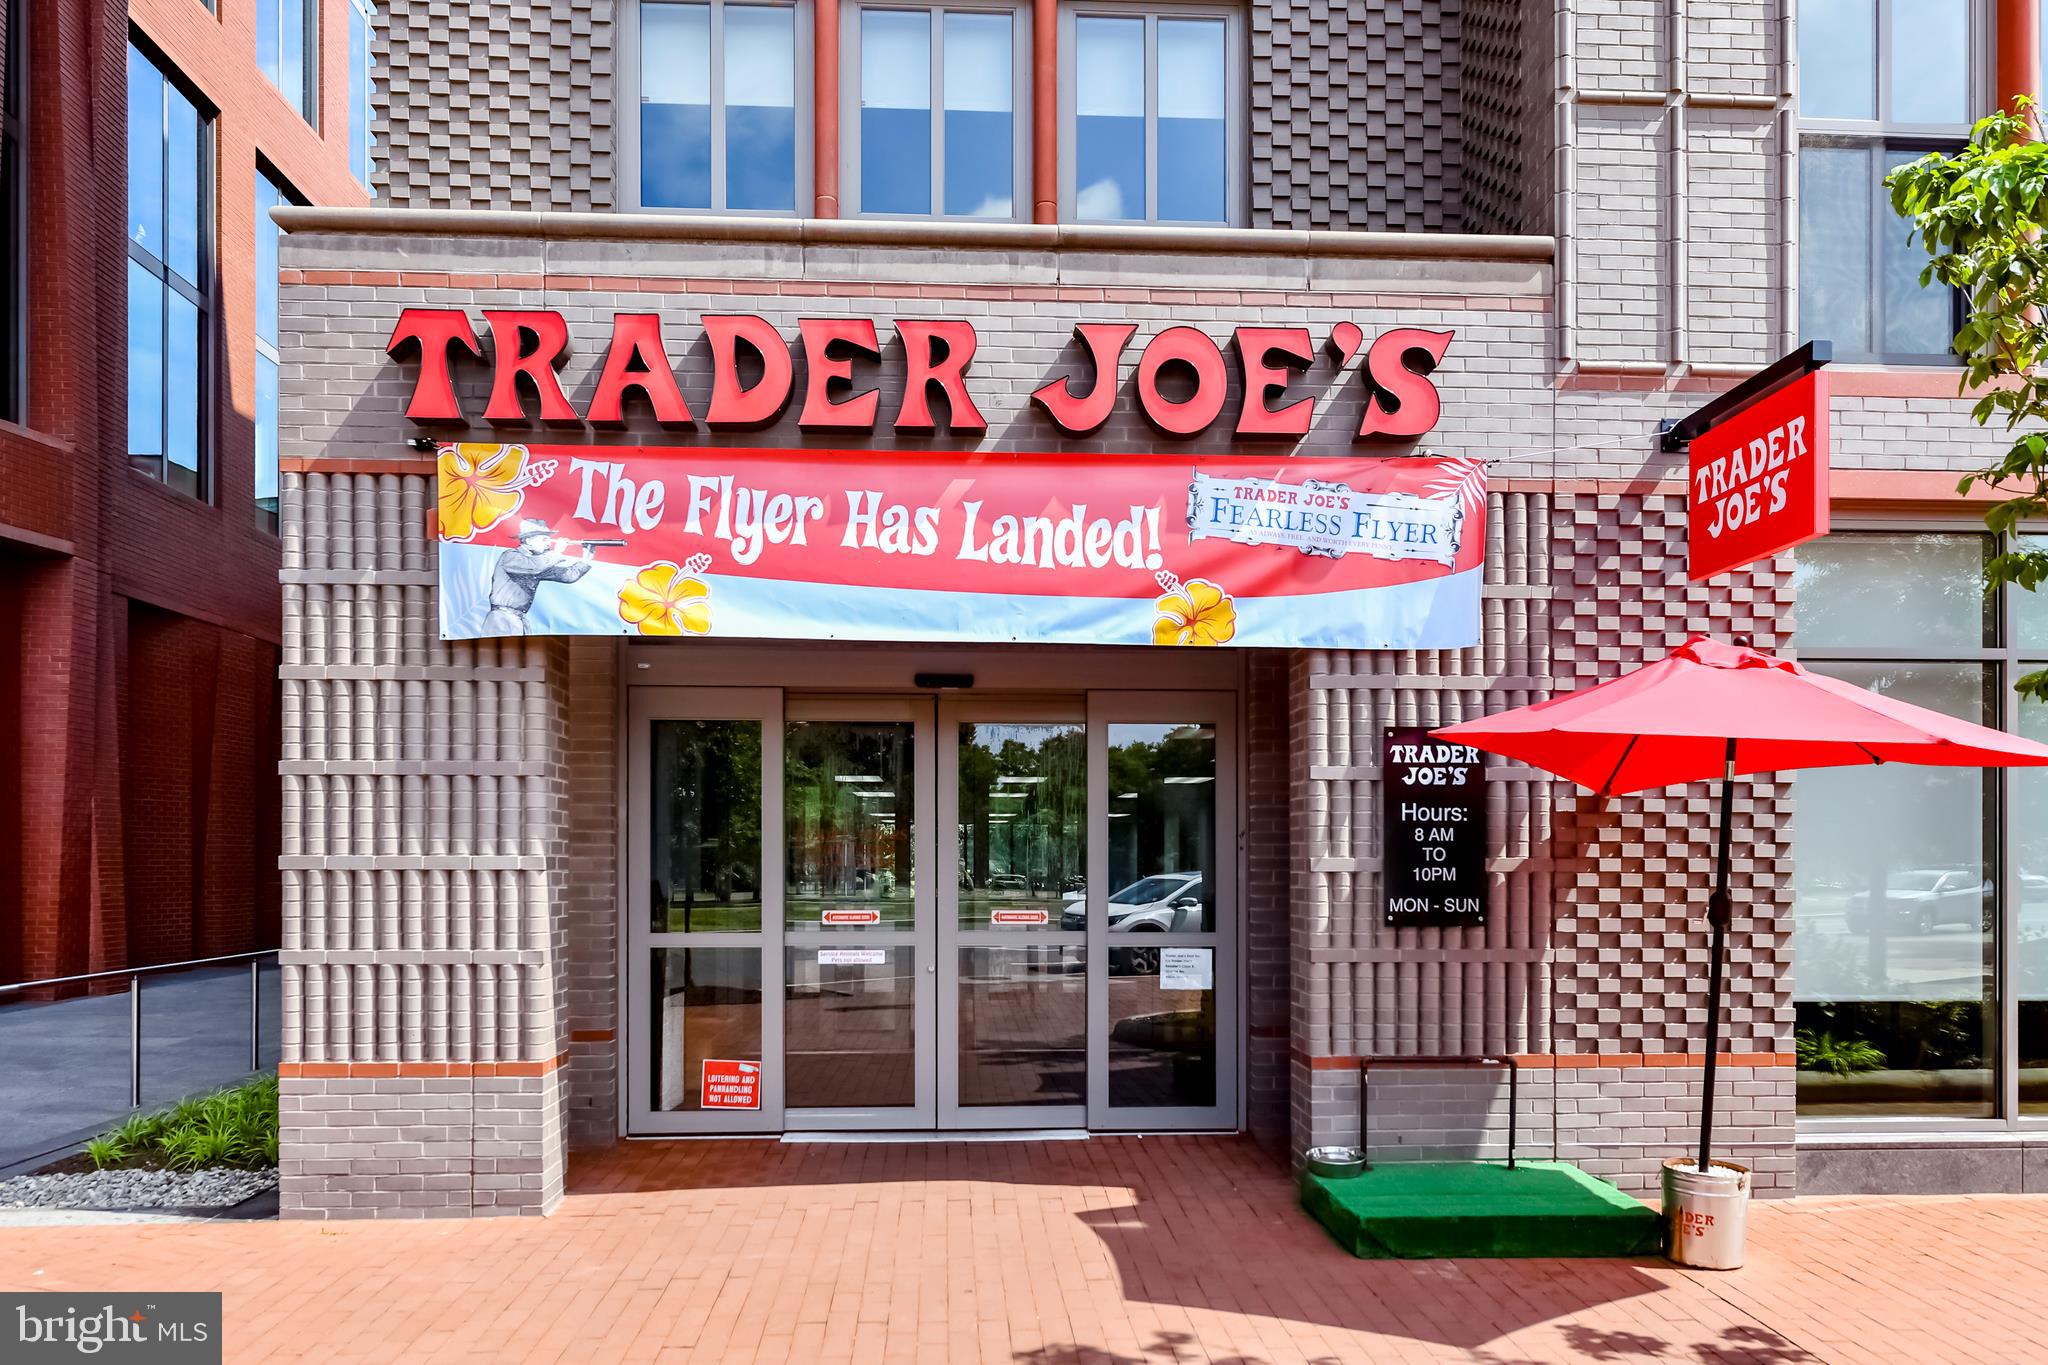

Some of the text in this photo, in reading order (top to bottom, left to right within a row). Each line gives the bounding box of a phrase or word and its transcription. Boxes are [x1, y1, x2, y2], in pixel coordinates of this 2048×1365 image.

[386, 308, 1456, 441] TRADER JOE'S
[1695, 415, 1808, 505] TRADER
[1234, 486, 1351, 510] TRADER JOE'S
[1707, 468, 1790, 539] JOE'S
[568, 456, 1164, 570] The Flyer Has Landed!
[1210, 496, 1438, 545] FEARLESS FLYER
[1389, 744, 1480, 764] TRADER
[1401, 766, 1469, 786] JOE'S
[1401, 802, 1468, 822] Hours:
[1414, 827, 1454, 842] 8 AM
[1422, 847, 1446, 861] TO
[1413, 867, 1456, 881] 10PM
[1389, 898, 1429, 912] MON
[1444, 898, 1480, 912] SUN
[708, 1074, 755, 1084] LOITERING AND
[710, 1085, 753, 1094] PANHANDLING
[709, 1094, 752, 1104] NOT ALLOWED
[1684, 1211, 1715, 1227] DER
[1682, 1223, 1706, 1237] E'S
